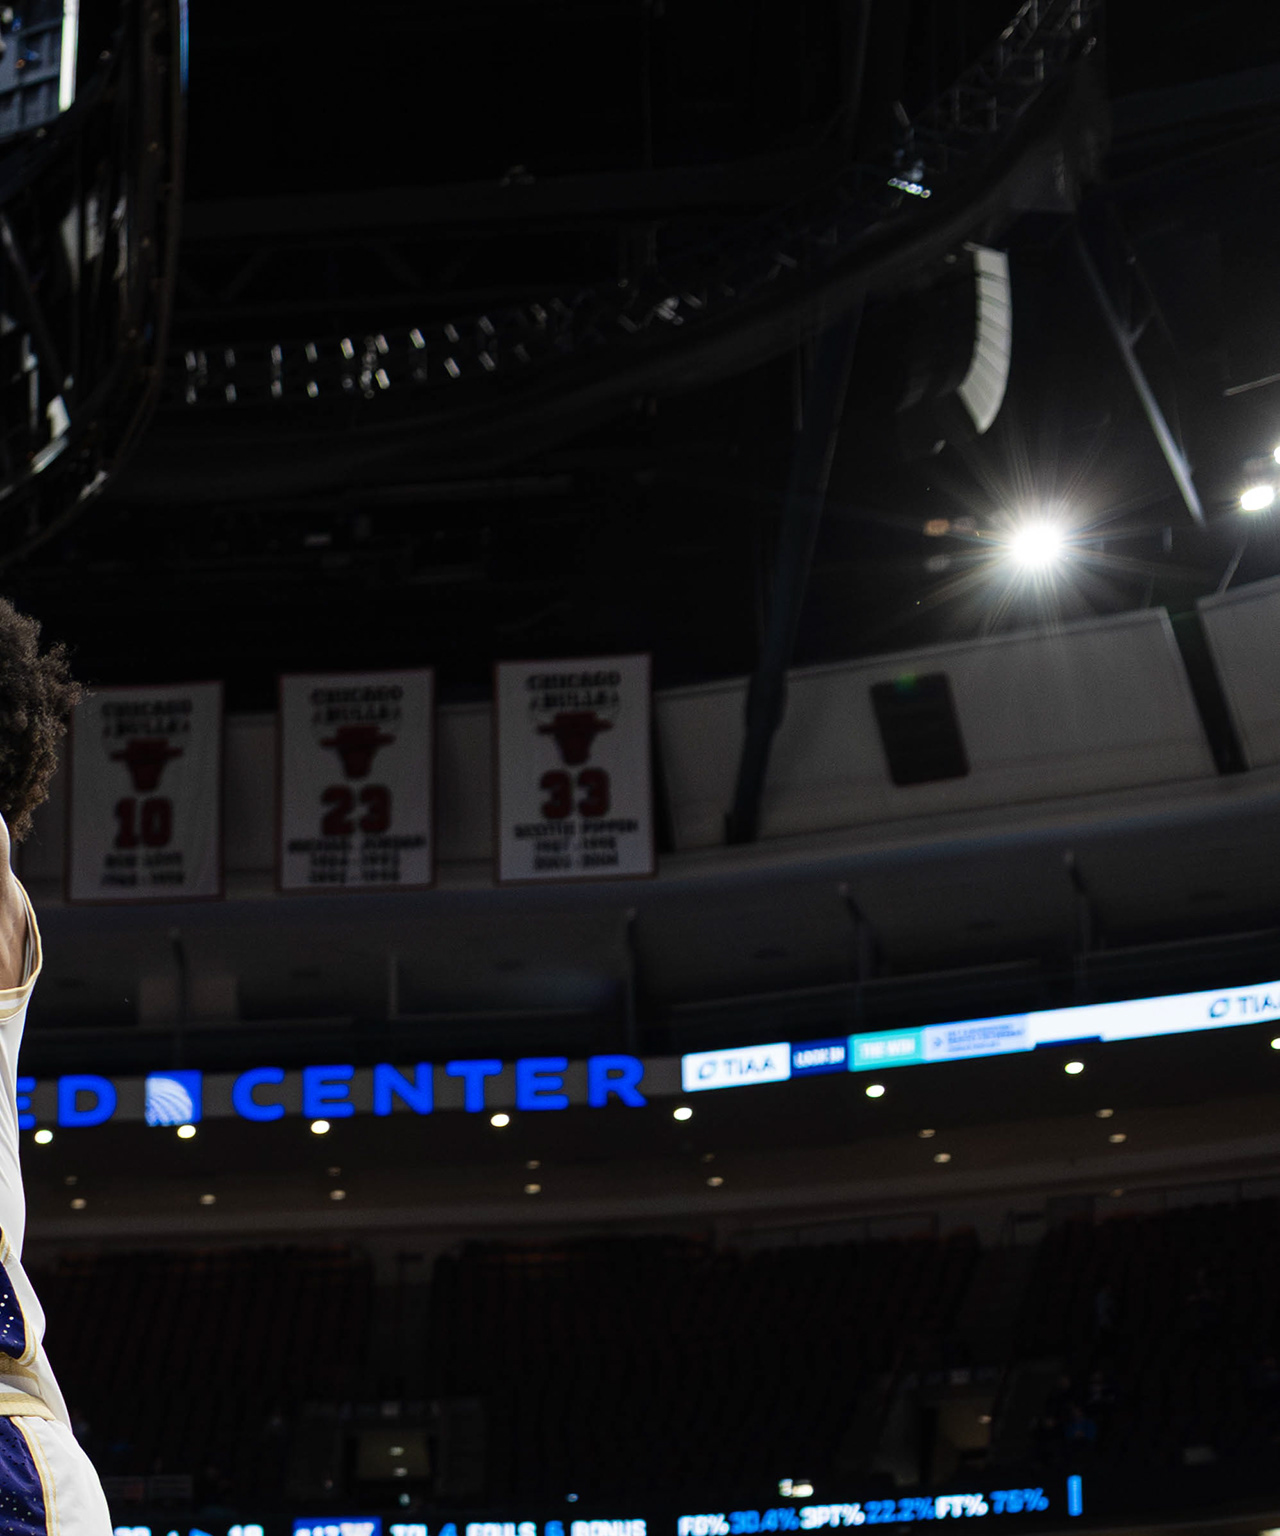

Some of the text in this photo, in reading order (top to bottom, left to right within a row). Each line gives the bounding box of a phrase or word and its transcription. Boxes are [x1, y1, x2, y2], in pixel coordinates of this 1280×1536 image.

[320, 783, 393, 837] 23
[540, 766, 611, 821] 33
[113, 795, 175, 850] 10
[232, 1054, 648, 1122] CENTER
[723, 1056, 777, 1078] TIAA
[799, 1502, 866, 1530] 3PT%
[864, 1496, 937, 1525] 22.2%
[934, 1492, 990, 1520] FT%
